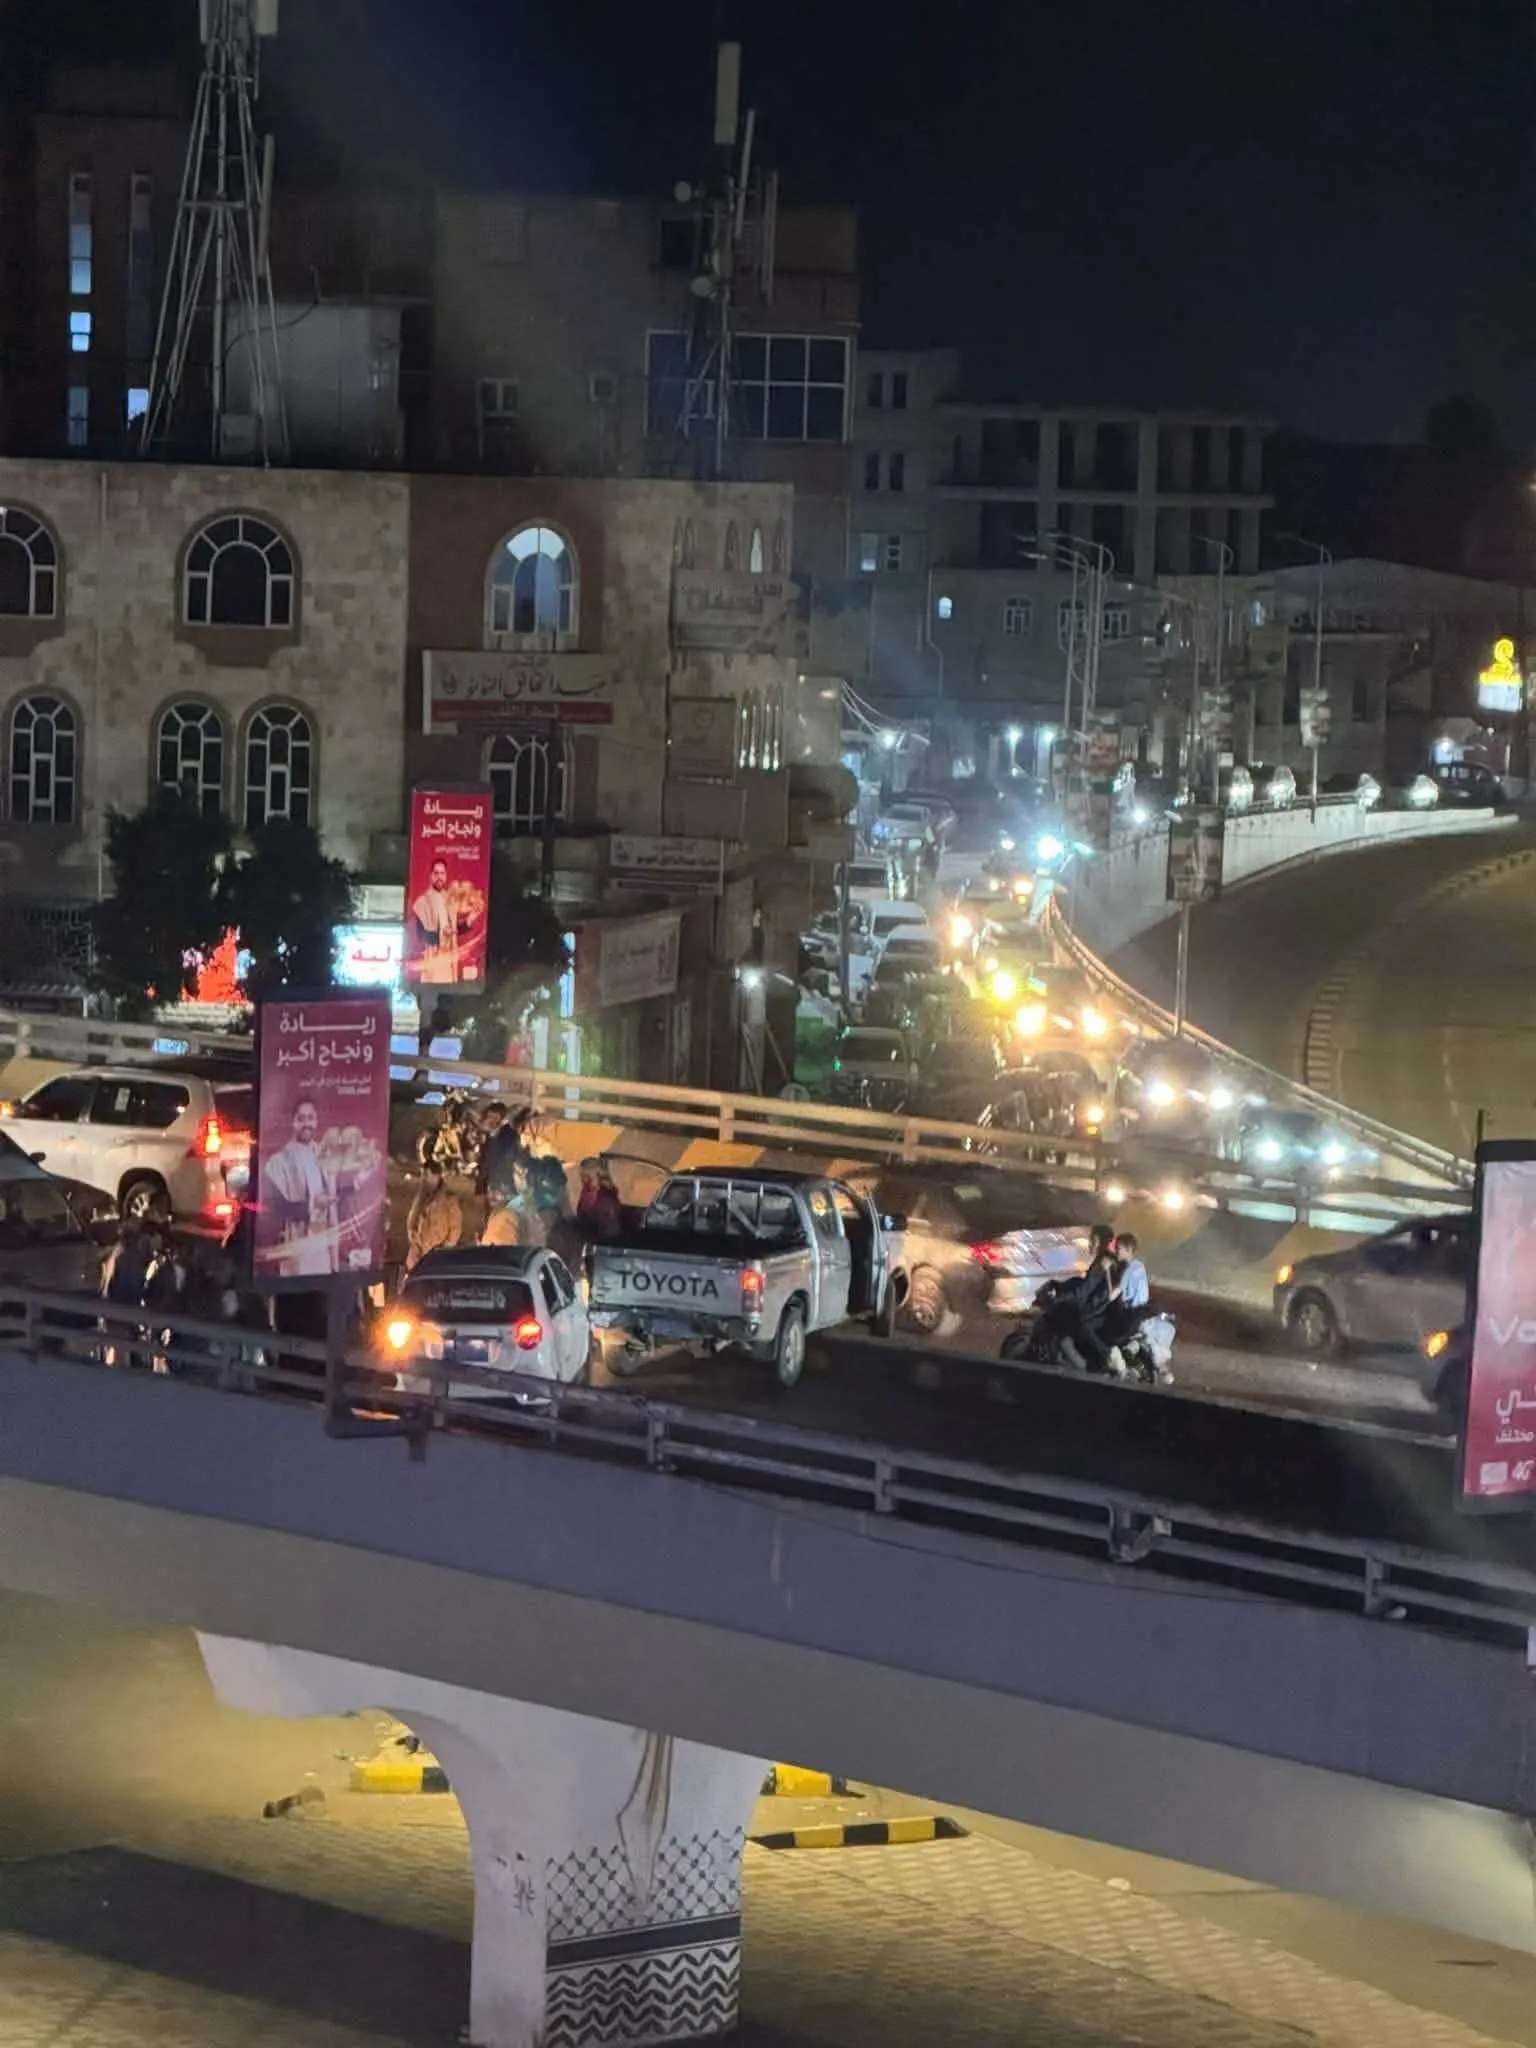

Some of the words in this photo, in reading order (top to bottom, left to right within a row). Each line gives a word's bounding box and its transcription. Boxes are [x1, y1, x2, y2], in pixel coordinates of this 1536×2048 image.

[447, 820, 482, 839] ونجاح
[279, 1009, 376, 1035] ريادة
[276, 1036, 315, 1067] أكبر
[318, 1038, 374, 1067] ونجاح
[618, 1269, 719, 1298] TOYOTA
